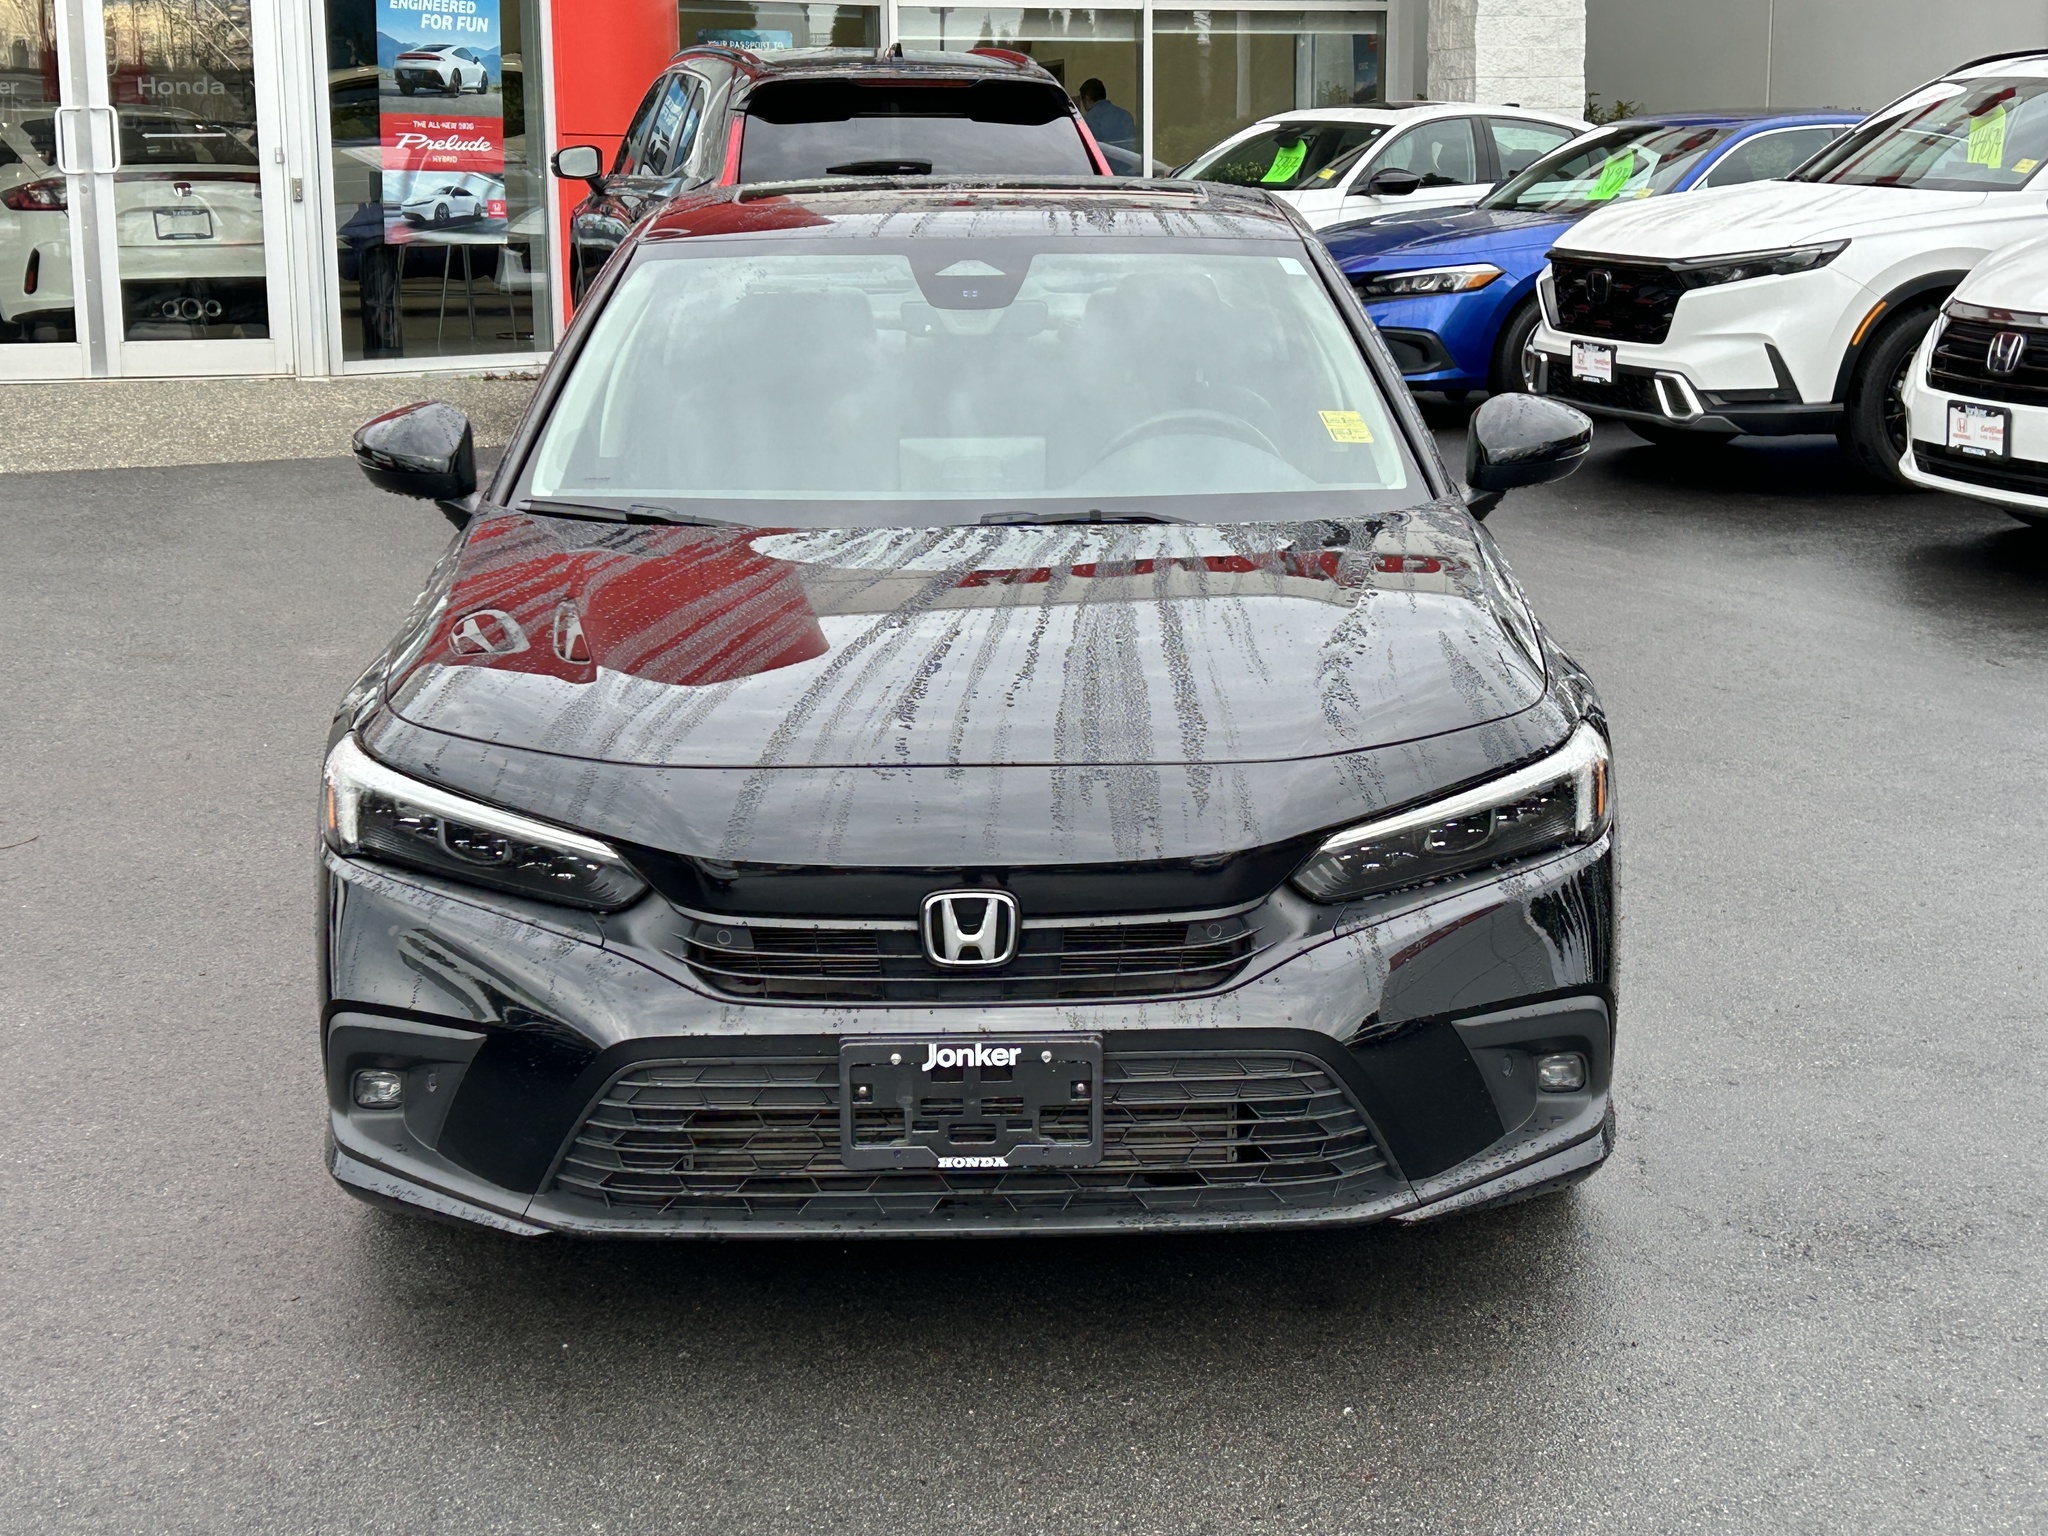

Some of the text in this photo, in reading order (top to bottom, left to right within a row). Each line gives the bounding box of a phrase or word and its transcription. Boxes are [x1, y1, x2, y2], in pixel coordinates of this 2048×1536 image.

[389, 0, 477, 14] ENGINEERED
[421, 14, 489, 33] FOR FUN
[729, 41, 771, 50] PASSPORT
[137, 76, 225, 95] Honda
[413, 120, 427, 129] THE
[395, 132, 493, 152] Prelude
[922, 1043, 1022, 1072] Jonker
[938, 1157, 1009, 1168] HONDA
